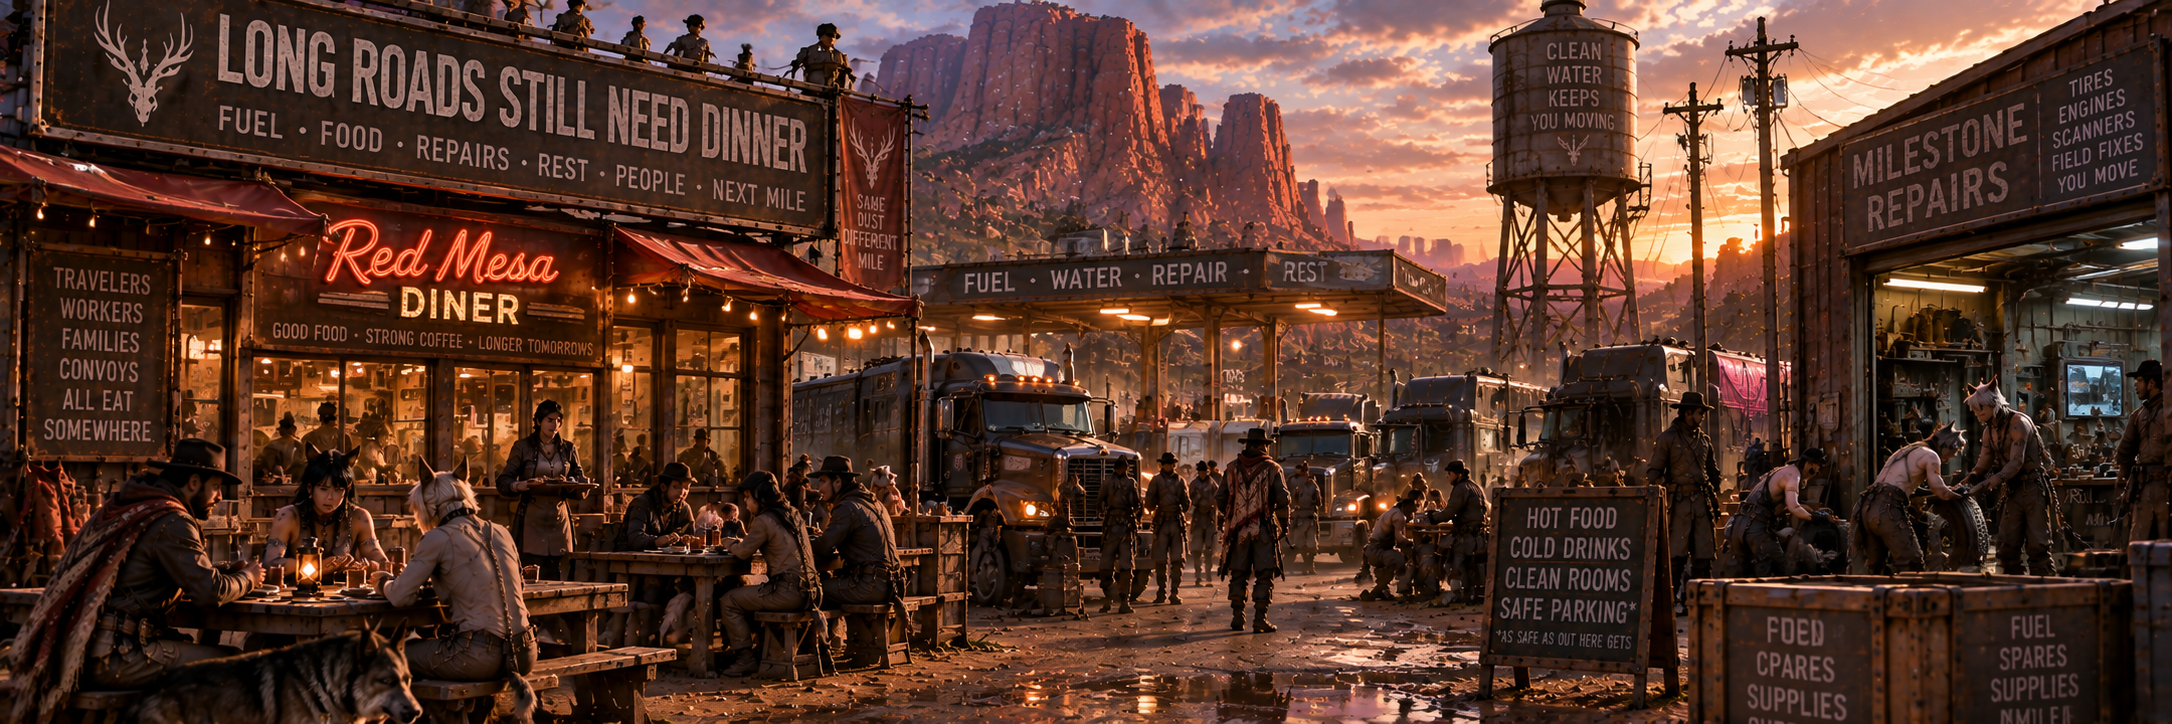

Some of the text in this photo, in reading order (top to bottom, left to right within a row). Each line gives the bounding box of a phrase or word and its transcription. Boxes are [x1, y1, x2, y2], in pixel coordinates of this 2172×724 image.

[1546, 42, 1601, 60] CLEAN
[1546, 65, 1602, 84] WATER
[2069, 68, 2113, 98] TIRES
[217, 13, 808, 174] LONG ROADS STILL NEED DINNER
[1548, 89, 1600, 107] KEEPS
[2058, 88, 2126, 125] ENGINES
[1530, 112, 1615, 131] YOU MOVING
[2052, 110, 2136, 149] SCANNERS
[218, 105, 806, 212] FUEL FOOD REPAIRS REST PEOPLE NEXT MILE
[1852, 102, 2028, 189] MILESTONE
[2052, 132, 2144, 172] FIELD FIXES
[2057, 158, 2139, 194] YOU MOVE
[1867, 161, 2009, 232] REPAIRS
[857, 211, 885, 230] DUST
[323, 219, 559, 284] Red Mesa
[843, 228, 898, 251] DIFFERENT
[858, 252, 884, 271] MILE
[53, 266, 151, 296] TRAVELERS
[964, 261, 1328, 294] FUEL WATER REPAIR REST
[60, 297, 143, 324] WORKERS
[401, 286, 519, 325] DINER
[61, 328, 140, 353] FAMILIES
[272, 322, 594, 356] GOOD FOOD STRONG COFFEE LONGER TOMORROWS
[59, 357, 139, 383] CONVOYS
[62, 388, 134, 412] ALL EAT
[1526, 507, 1618, 530] HOT FOOD
[1509, 536, 1632, 561] COLD DRINKS
[1504, 566, 1632, 593] CLEAN ROOMS
[1499, 596, 1544, 621] SAFE
[1517, 630, 1539, 645] SAFE
[1541, 631, 1555, 645] AS
[1558, 632, 1577, 647] OUT
[1579, 633, 1603, 648] HERE
[1607, 634, 1632, 650] GETS
[2011, 614, 2056, 640] FUEL
[1756, 650, 1835, 683] CPARES
[1999, 643, 2068, 671] SPARES
[1747, 683, 1848, 721] SUPPLIES
[1991, 673, 2079, 703] SUPPLIES
